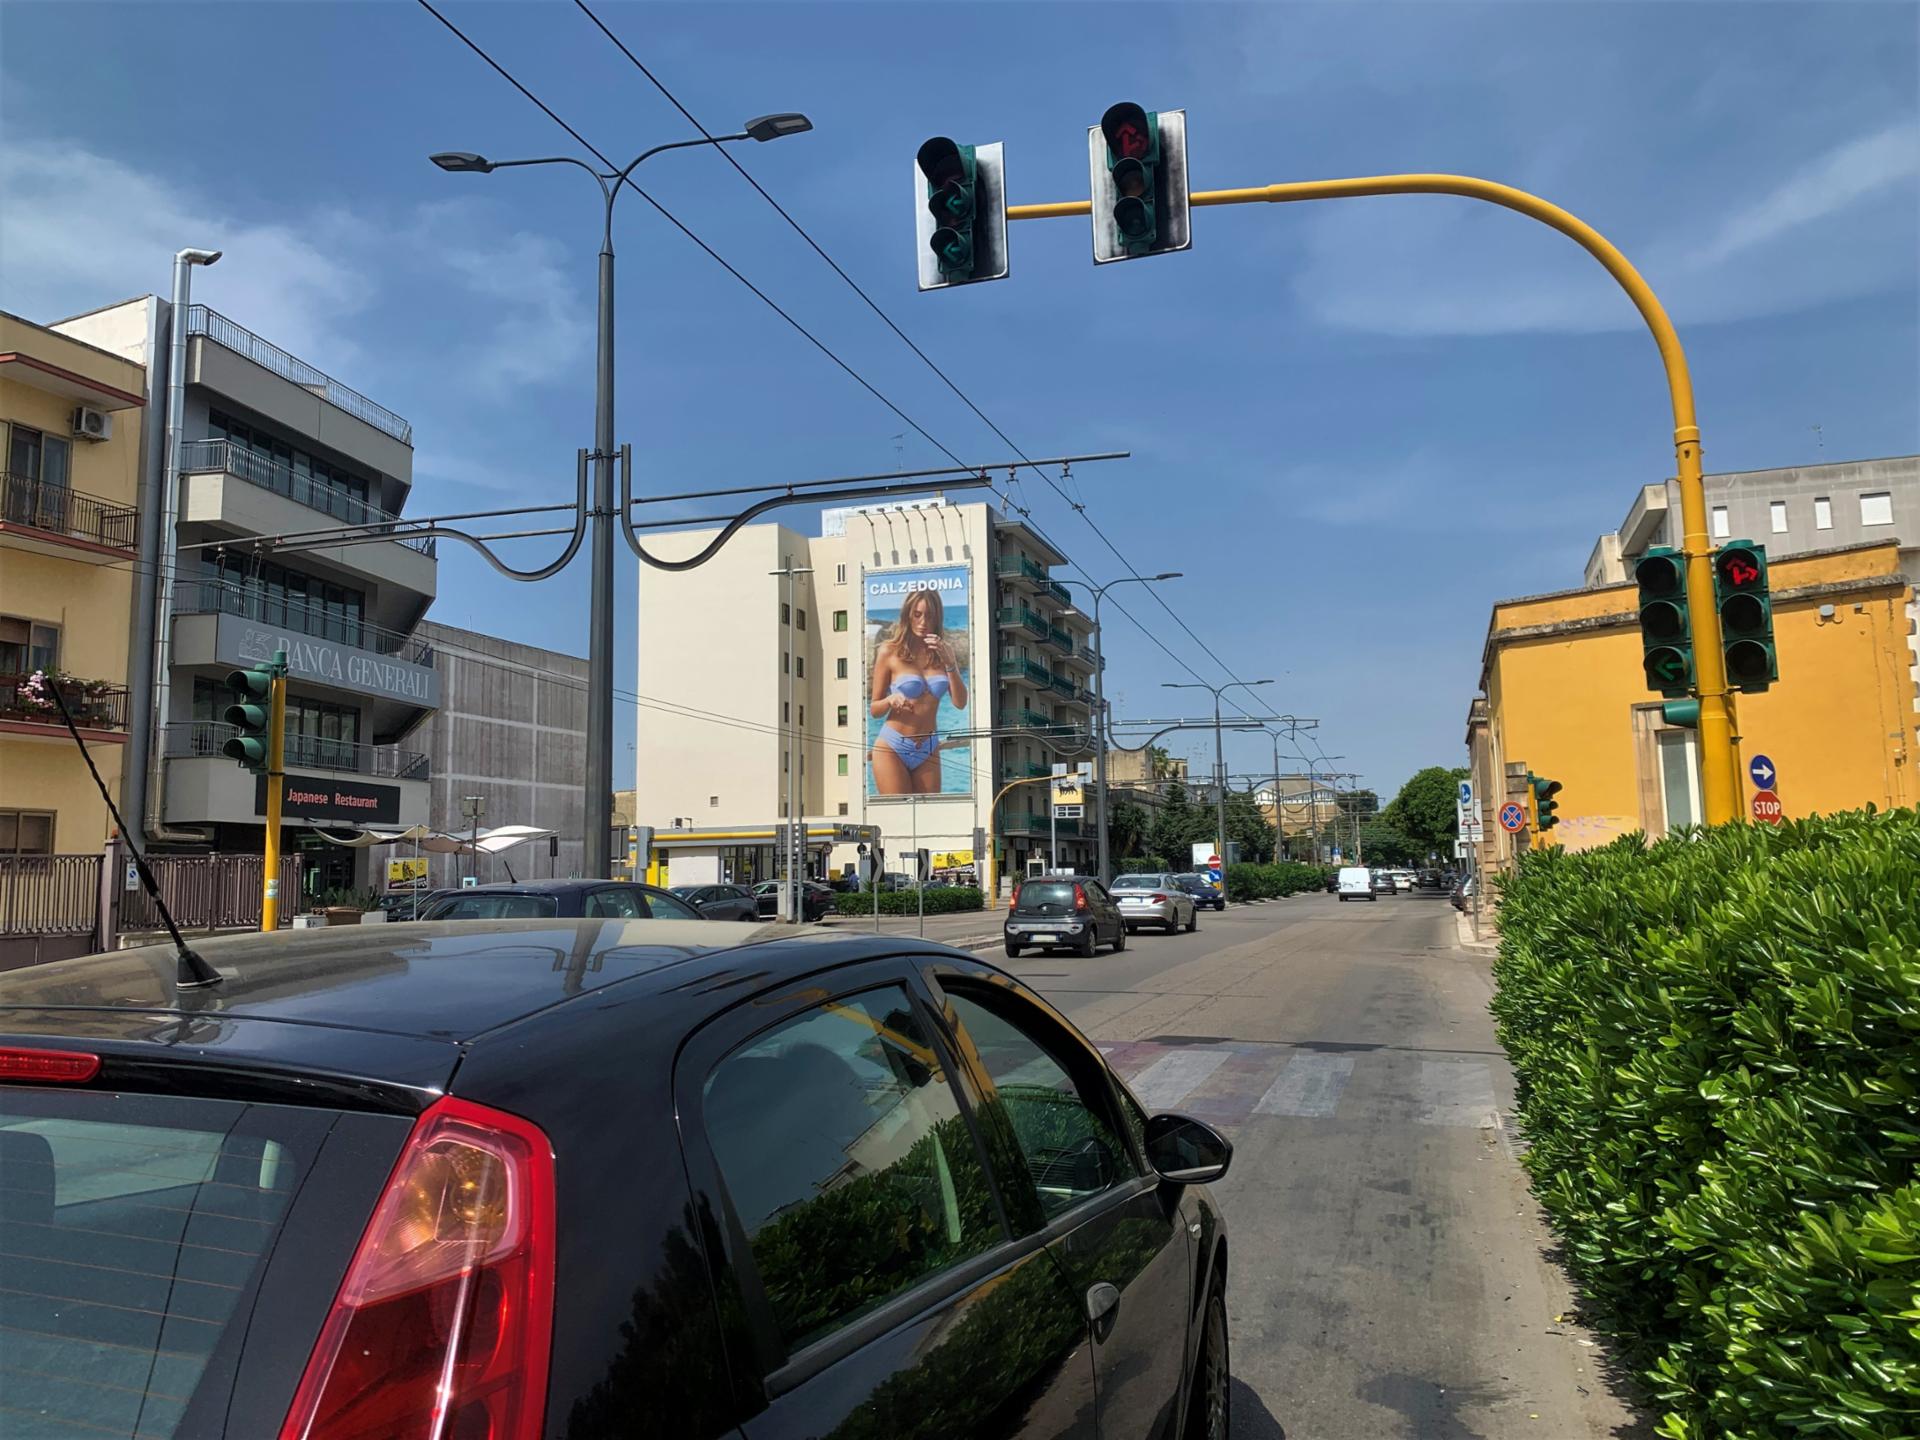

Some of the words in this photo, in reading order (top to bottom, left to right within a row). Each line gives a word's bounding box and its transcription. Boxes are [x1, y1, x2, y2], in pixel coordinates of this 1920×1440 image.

[870, 577, 963, 594] CALZEDONIA
[278, 637, 344, 680] BANCA
[348, 655, 430, 699] GENERALI
[287, 788, 329, 805] Japanese
[334, 792, 378, 808] Restaurant
[1754, 801, 1780, 815] STOP
